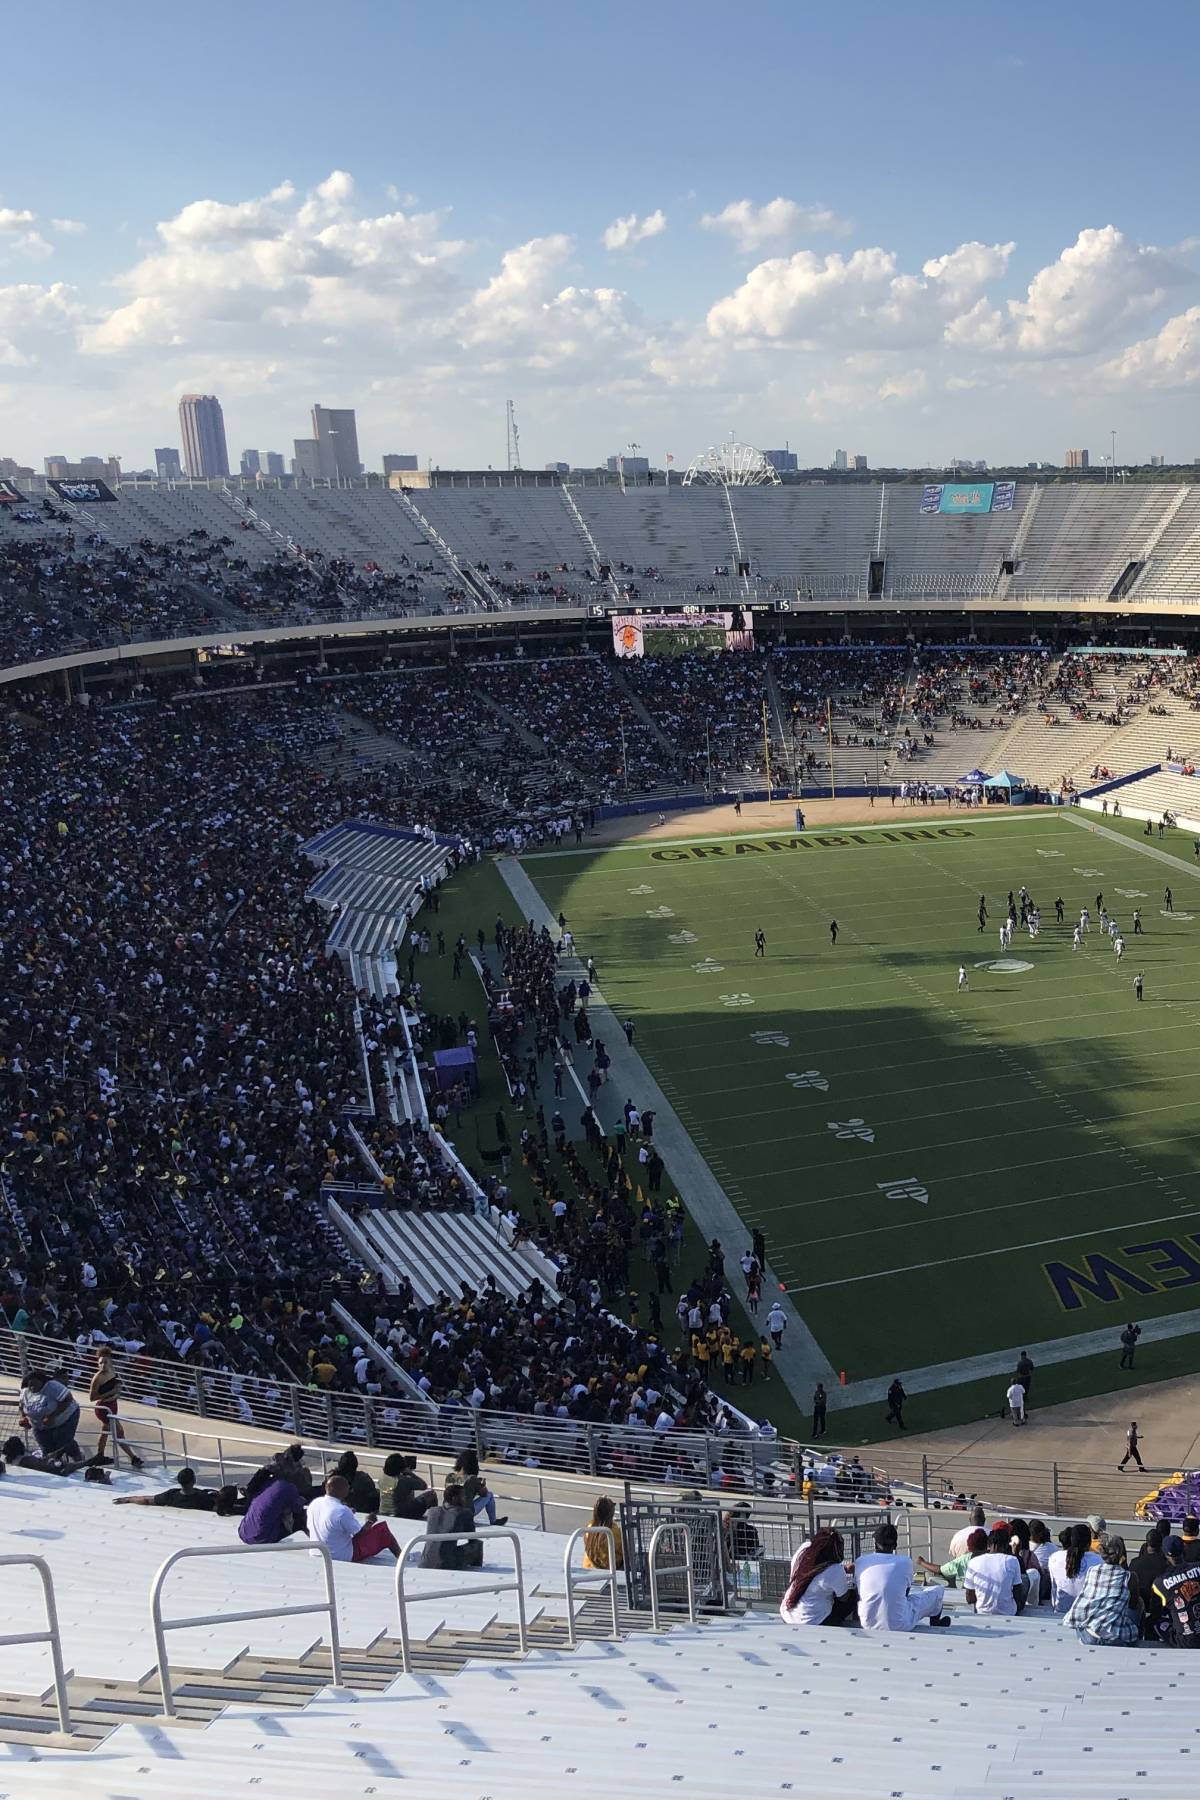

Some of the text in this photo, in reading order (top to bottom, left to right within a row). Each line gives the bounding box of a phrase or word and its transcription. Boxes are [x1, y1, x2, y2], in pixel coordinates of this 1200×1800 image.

[592, 605, 603, 616] 15
[683, 605, 699, 614] 10:04
[780, 600, 790, 611] 15
[651, 828, 976, 861] GRAMBLING
[719, 993, 755, 1007] 50
[750, 1030, 790, 1046] 40
[785, 1070, 830, 1090] 30
[827, 1118, 874, 1140] 20
[876, 1176, 929, 1201] 10
[1163, 1572, 1187, 1589] OSAKA
